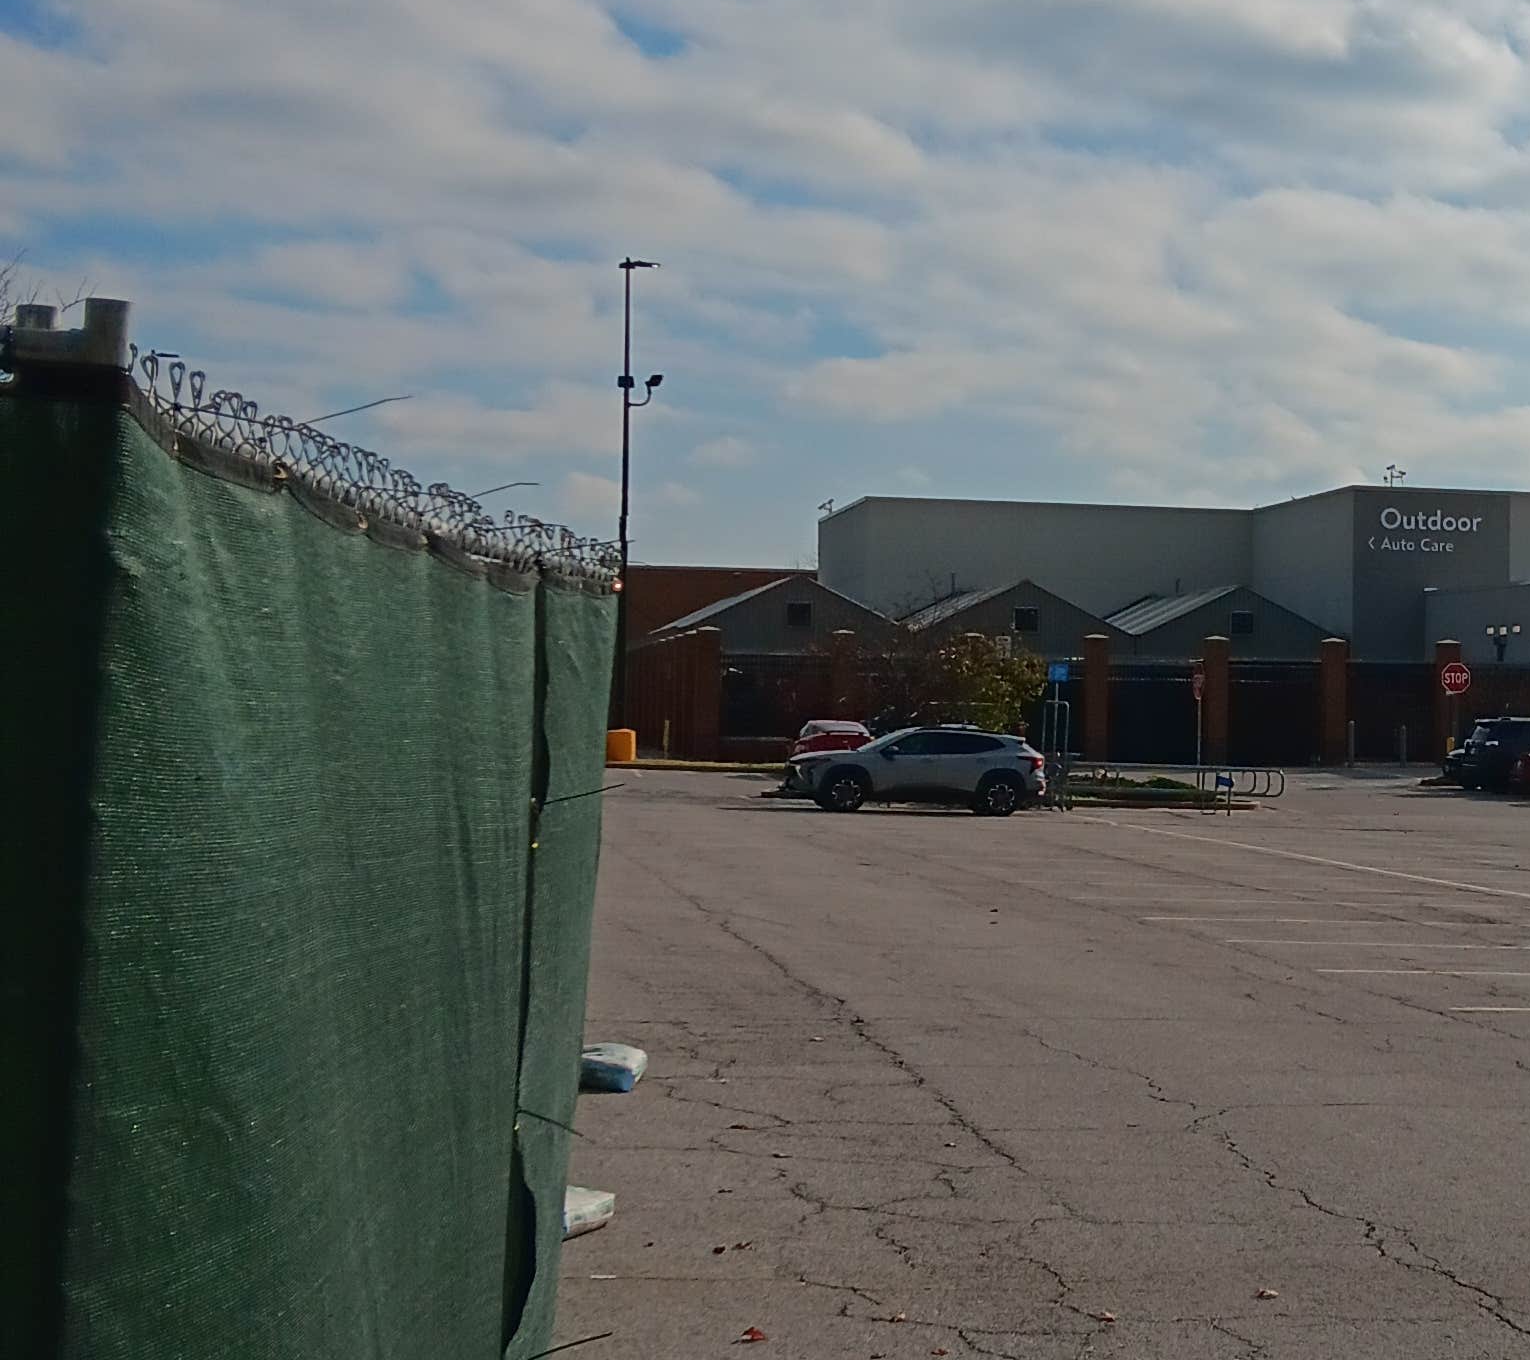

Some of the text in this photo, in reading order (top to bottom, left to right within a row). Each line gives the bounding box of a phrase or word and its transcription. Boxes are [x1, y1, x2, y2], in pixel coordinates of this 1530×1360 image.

[1380, 507, 1483, 532] Outdoor
[1380, 537, 1454, 552] Auto Care
[1444, 672, 1469, 684] STOP
